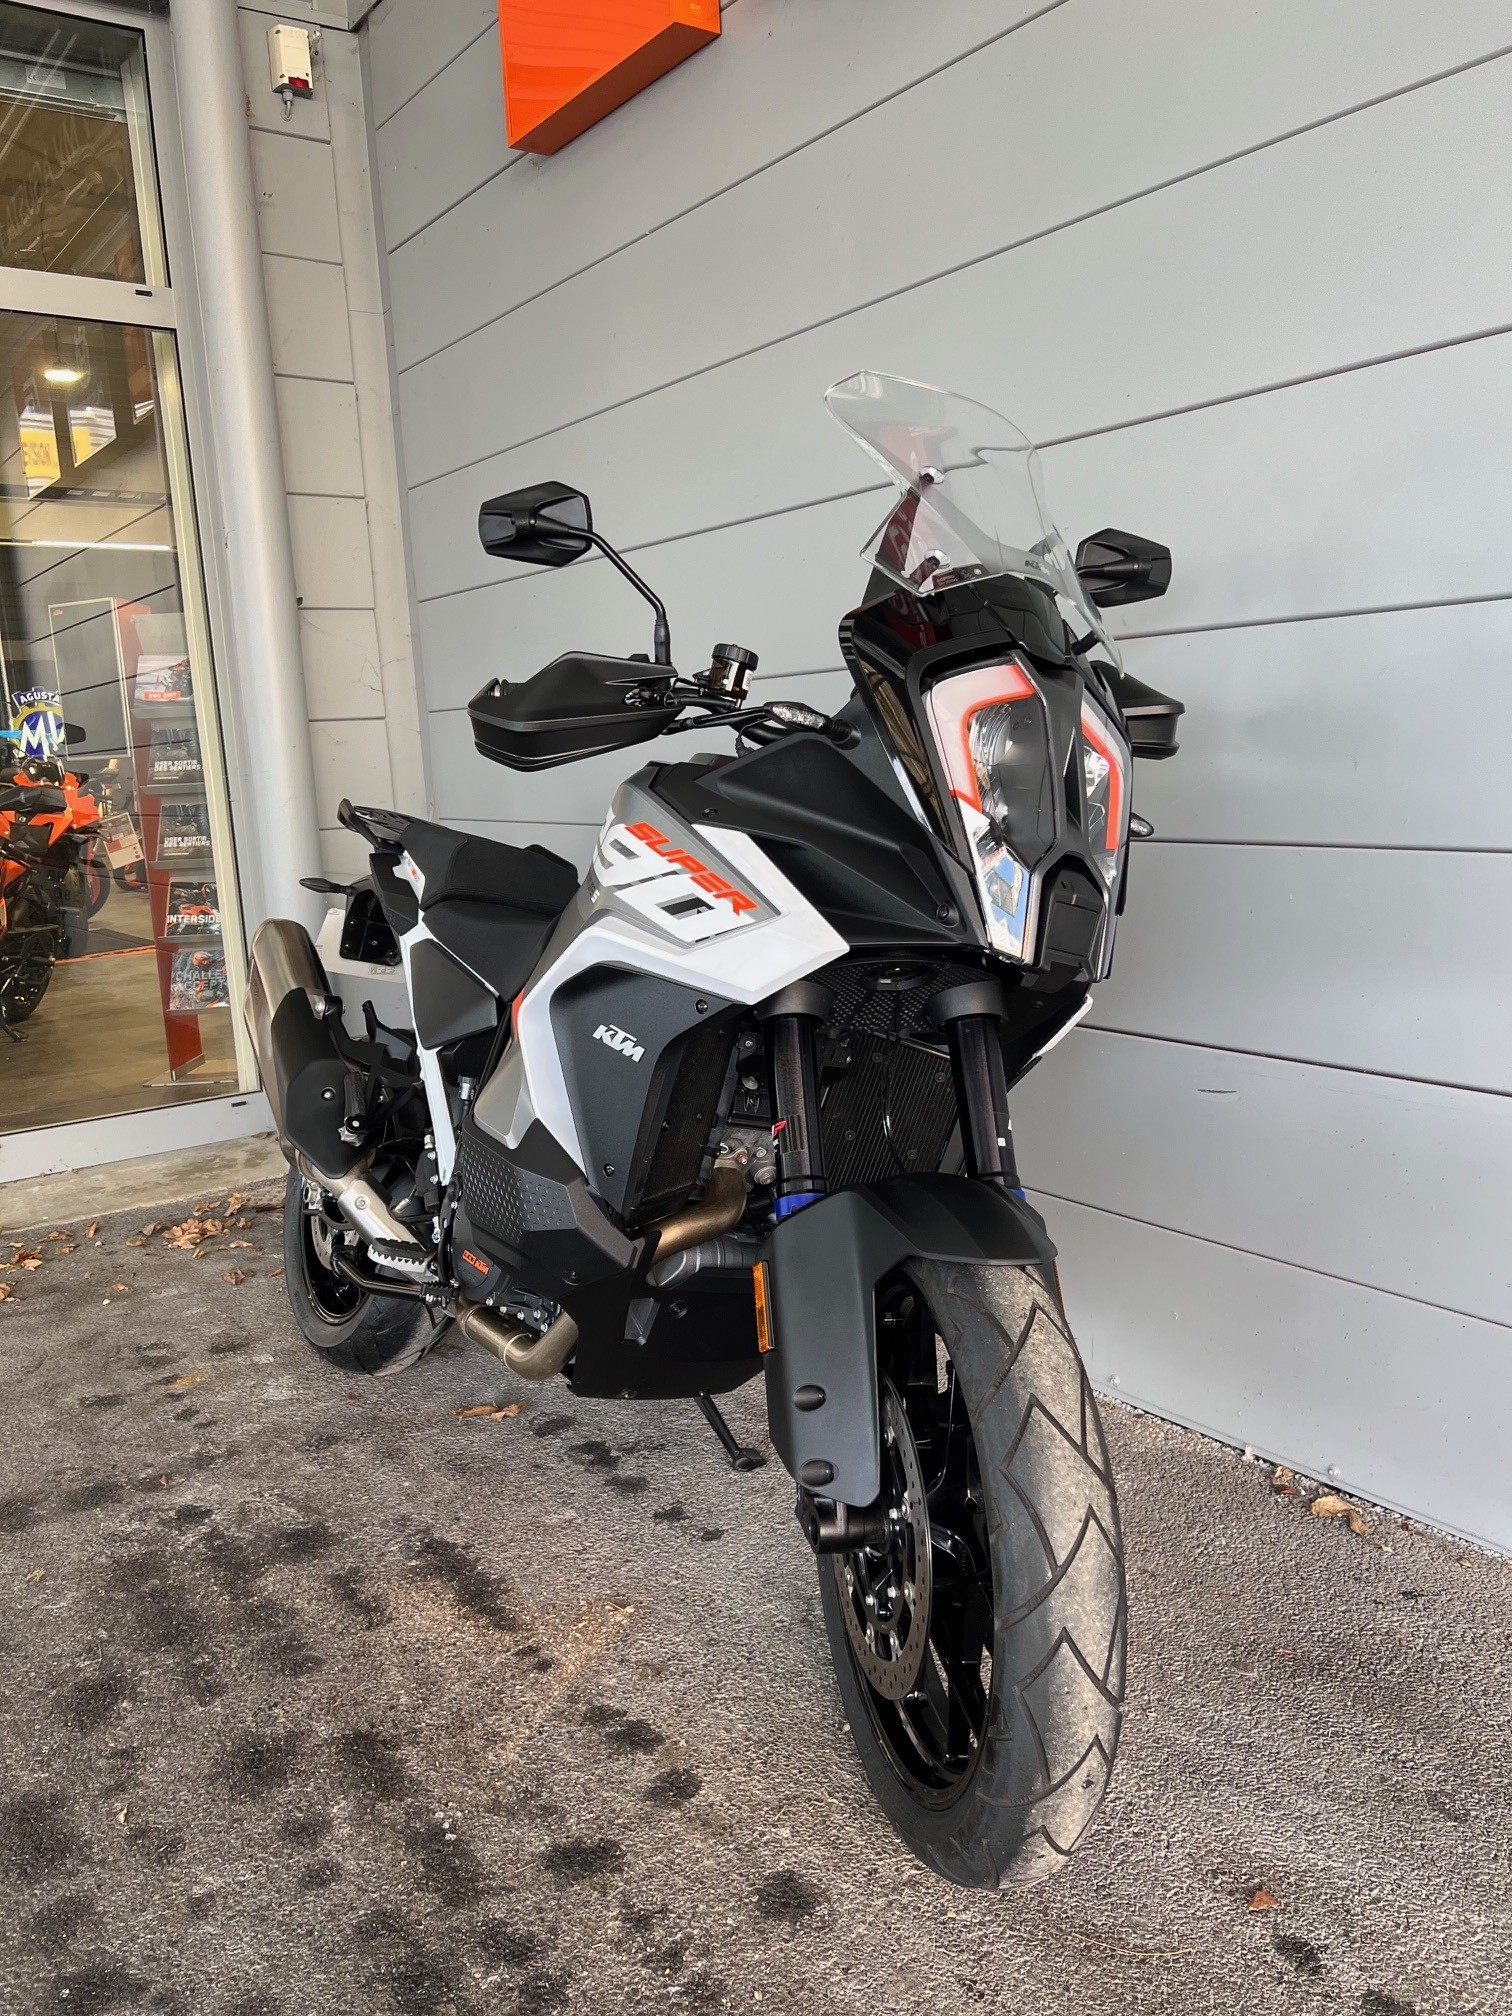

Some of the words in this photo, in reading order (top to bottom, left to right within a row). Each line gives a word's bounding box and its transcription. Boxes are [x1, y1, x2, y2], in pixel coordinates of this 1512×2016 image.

[20, 691, 60, 704] AGUSTA
[19, 711, 66, 761] MV
[624, 821, 757, 917] SUPER
[167, 914, 219, 924] INTERSID
[592, 1024, 647, 1063] KTM
[474, 1259, 490, 1275] KTM
